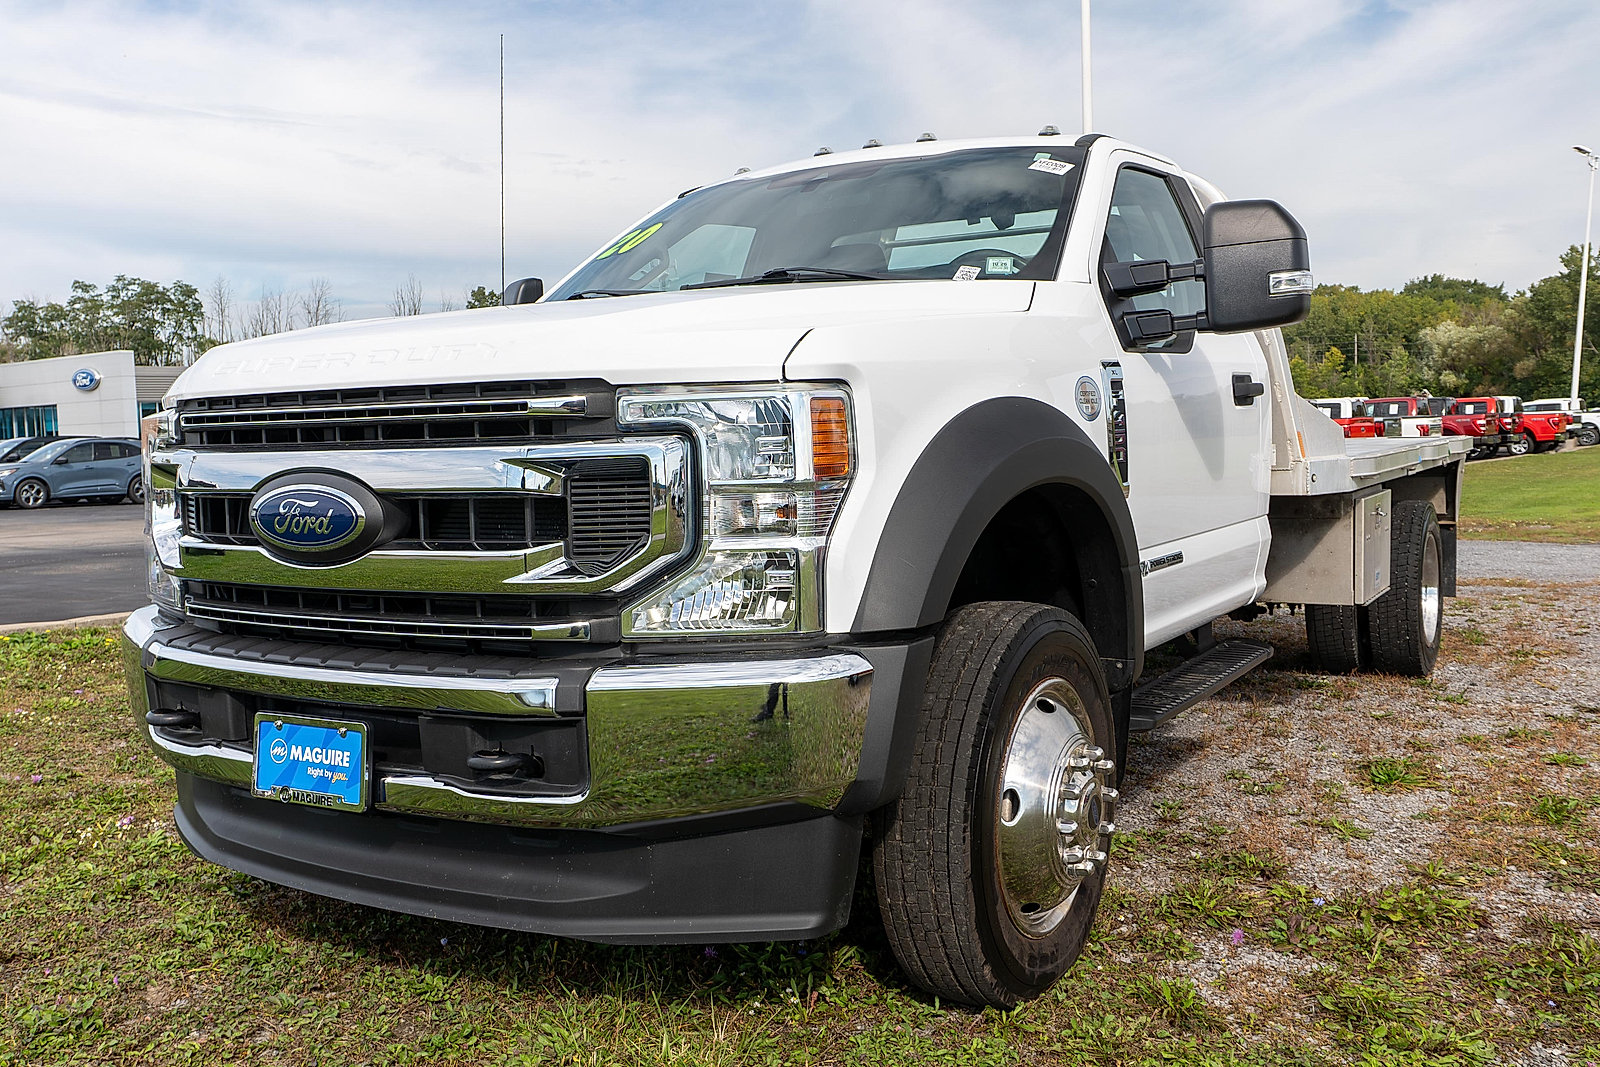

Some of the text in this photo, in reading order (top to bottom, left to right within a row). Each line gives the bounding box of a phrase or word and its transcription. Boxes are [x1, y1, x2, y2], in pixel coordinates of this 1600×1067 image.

[213, 341, 505, 377] SUPER DUTY
[76, 373, 90, 386] Ford
[273, 498, 334, 535] Ford
[289, 744, 351, 768] MAGUIRE
[307, 766, 324, 779] Right
[324, 769, 333, 780] by
[292, 790, 334, 807] MAGUIRE
